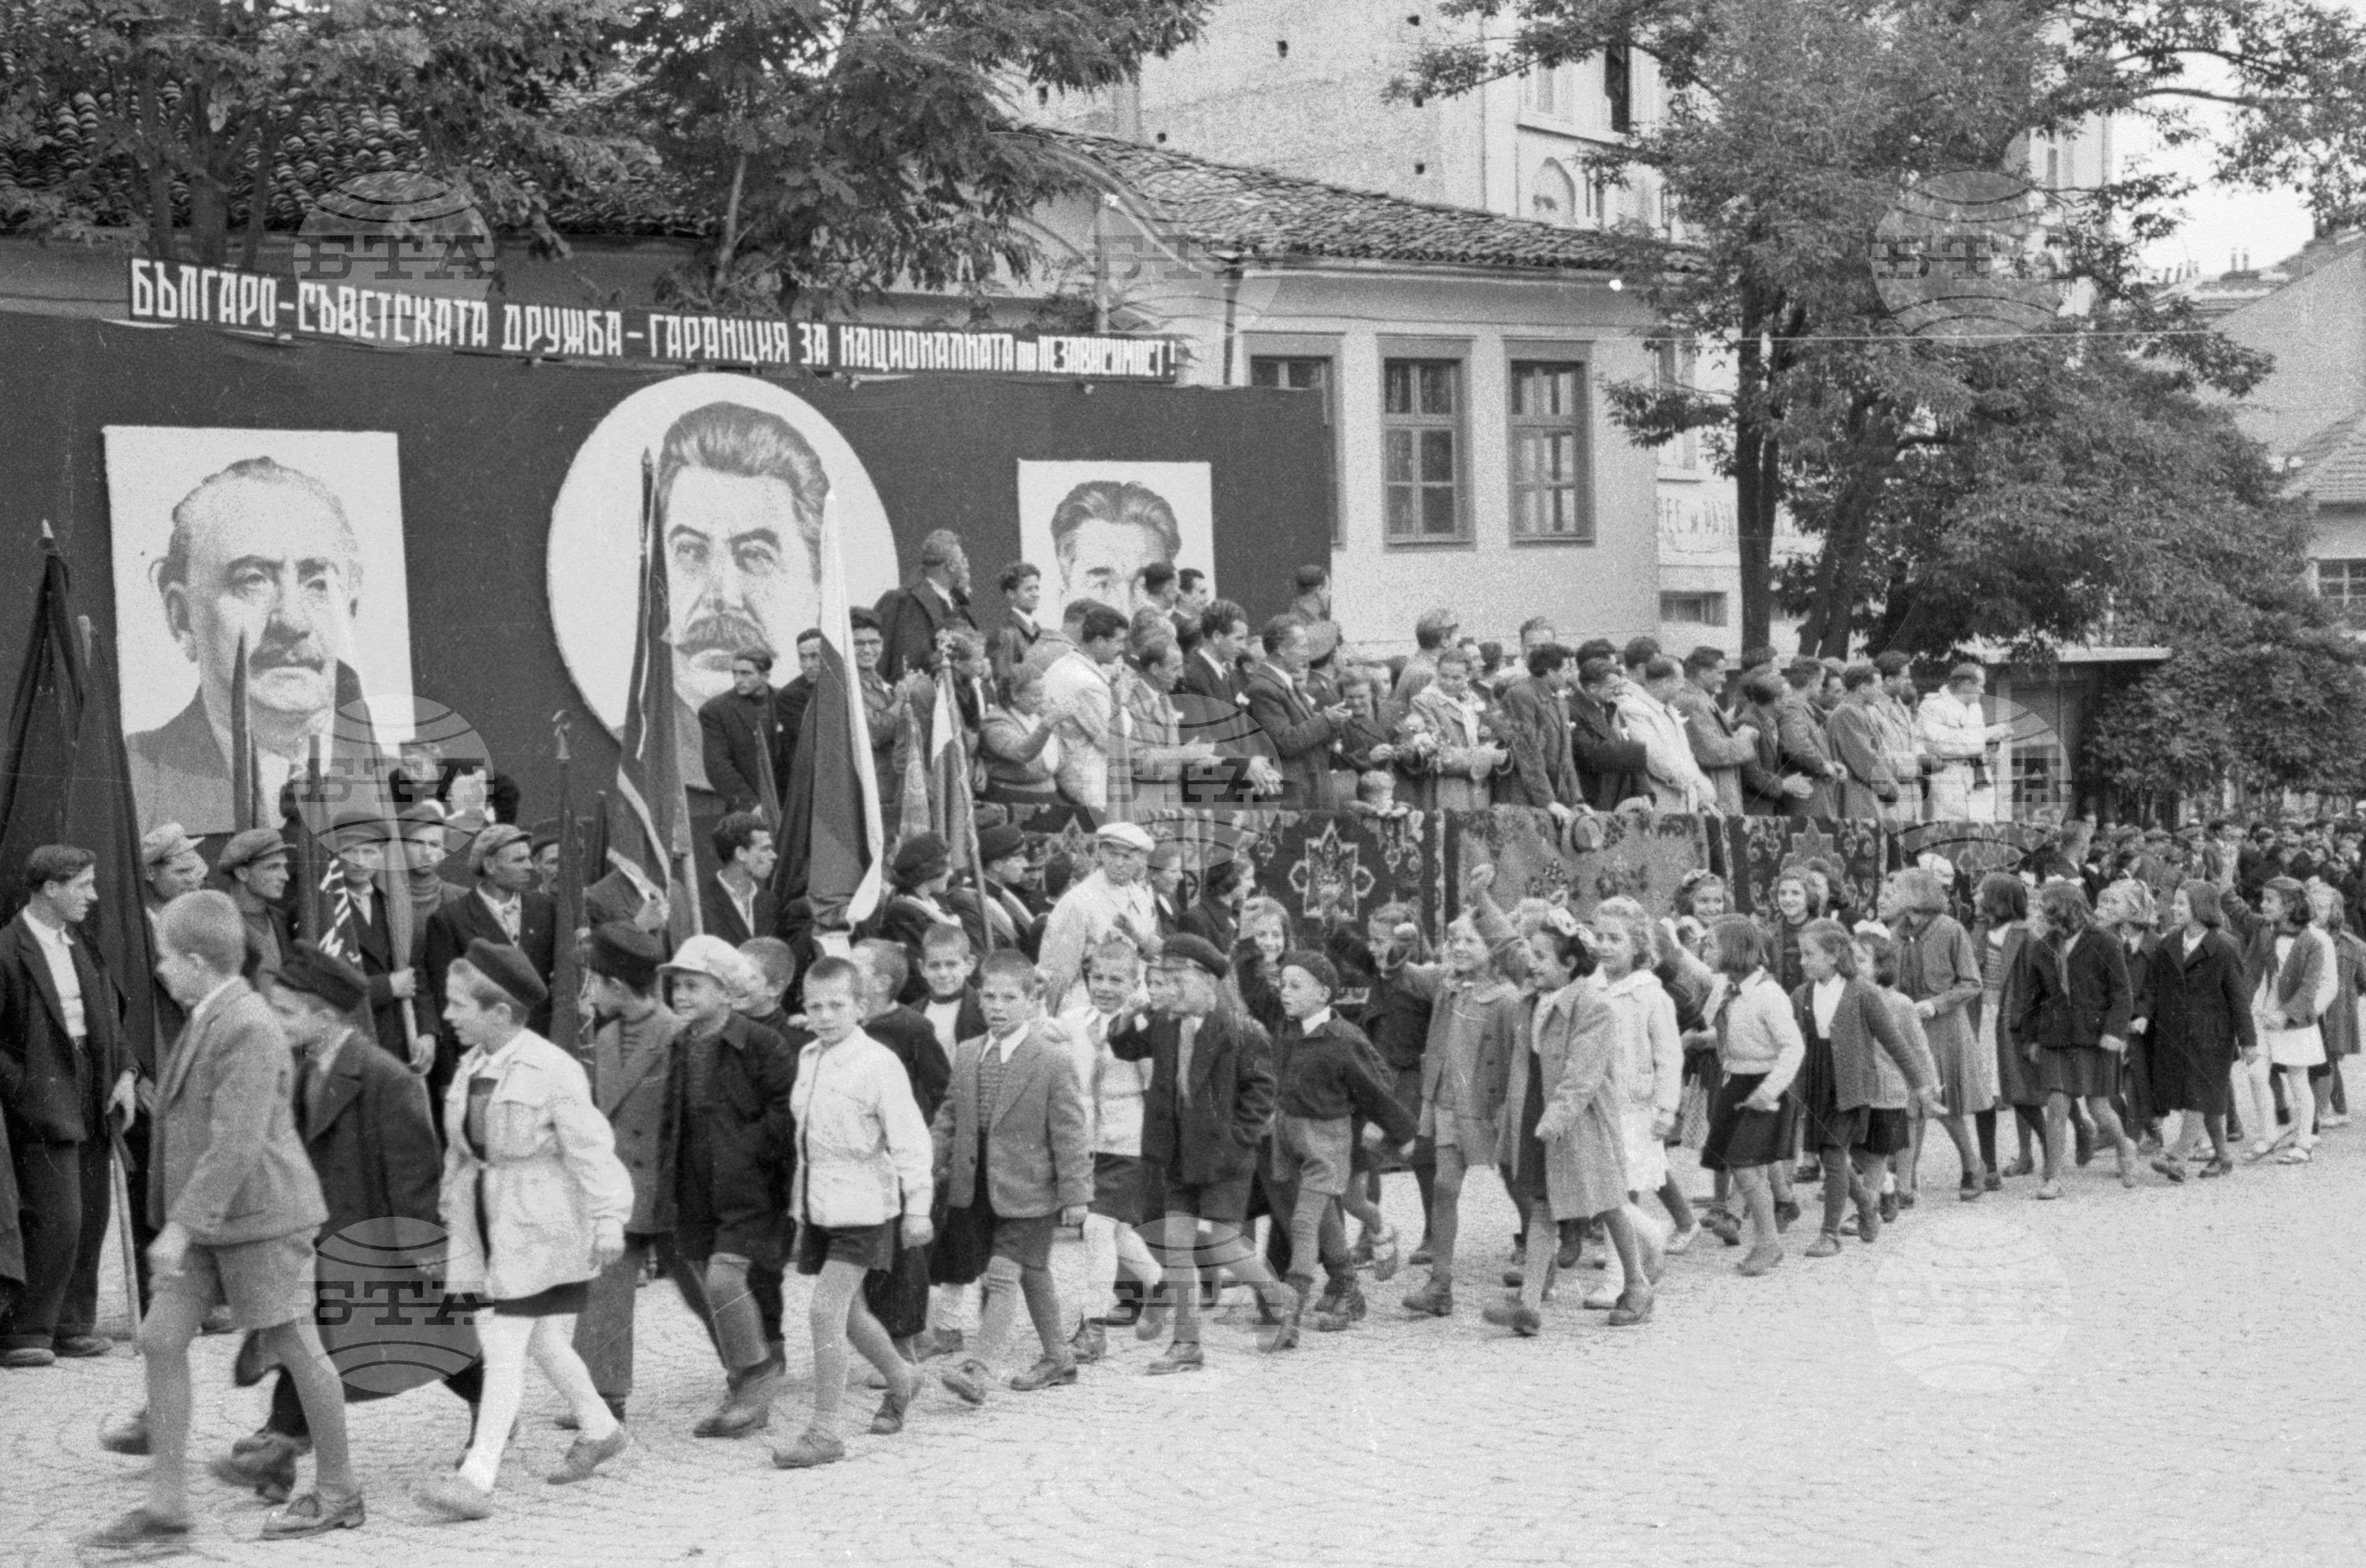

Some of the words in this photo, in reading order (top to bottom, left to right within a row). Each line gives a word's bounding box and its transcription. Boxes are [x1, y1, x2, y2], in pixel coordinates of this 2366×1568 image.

[132, 258, 489, 348] БЪЛГАРО-СЪВЕТСКАТА
[502, 303, 622, 356] ДРУЖБА
[649, 313, 790, 364] ГАРАНЦИЯ
[797, 322, 828, 366] ЗА
[840, 325, 1014, 371] НАЦИОНАЛНАТА
